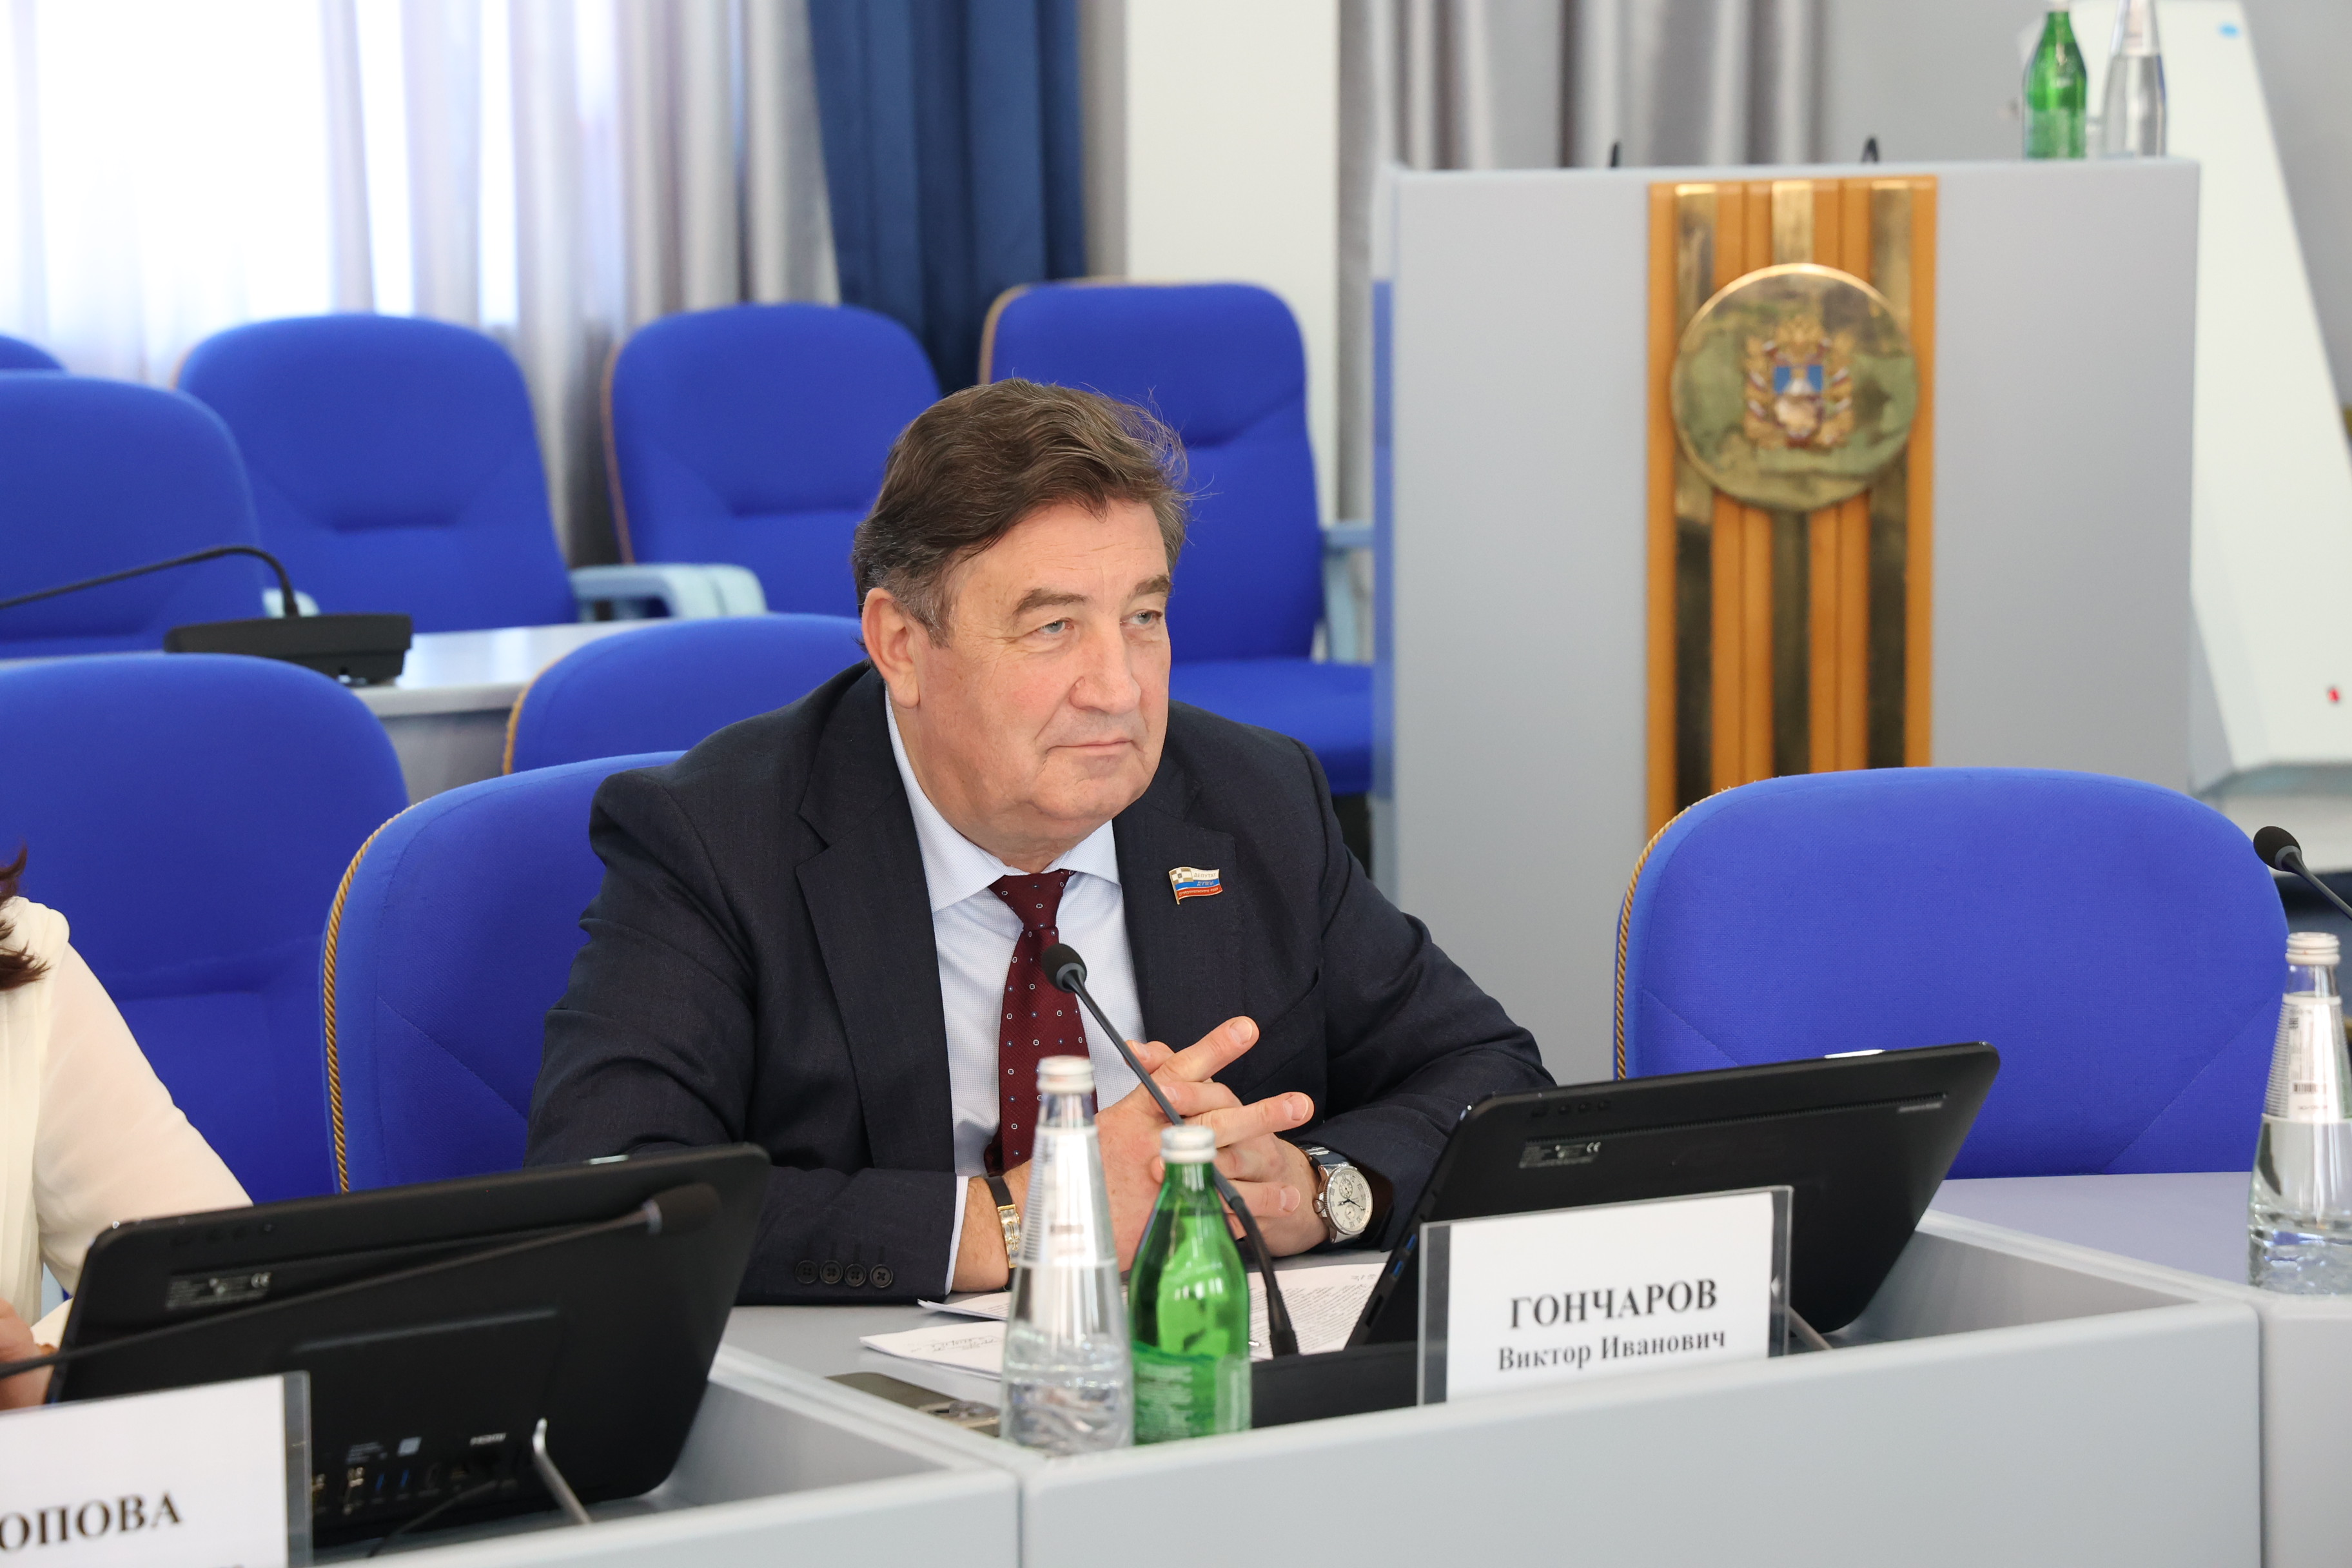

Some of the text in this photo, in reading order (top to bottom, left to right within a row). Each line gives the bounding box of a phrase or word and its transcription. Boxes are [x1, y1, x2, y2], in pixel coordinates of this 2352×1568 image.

[1510, 1279, 1717, 1329] ГОНЧАРОВ
[1499, 1330, 1726, 1370] Виктор Иванович
